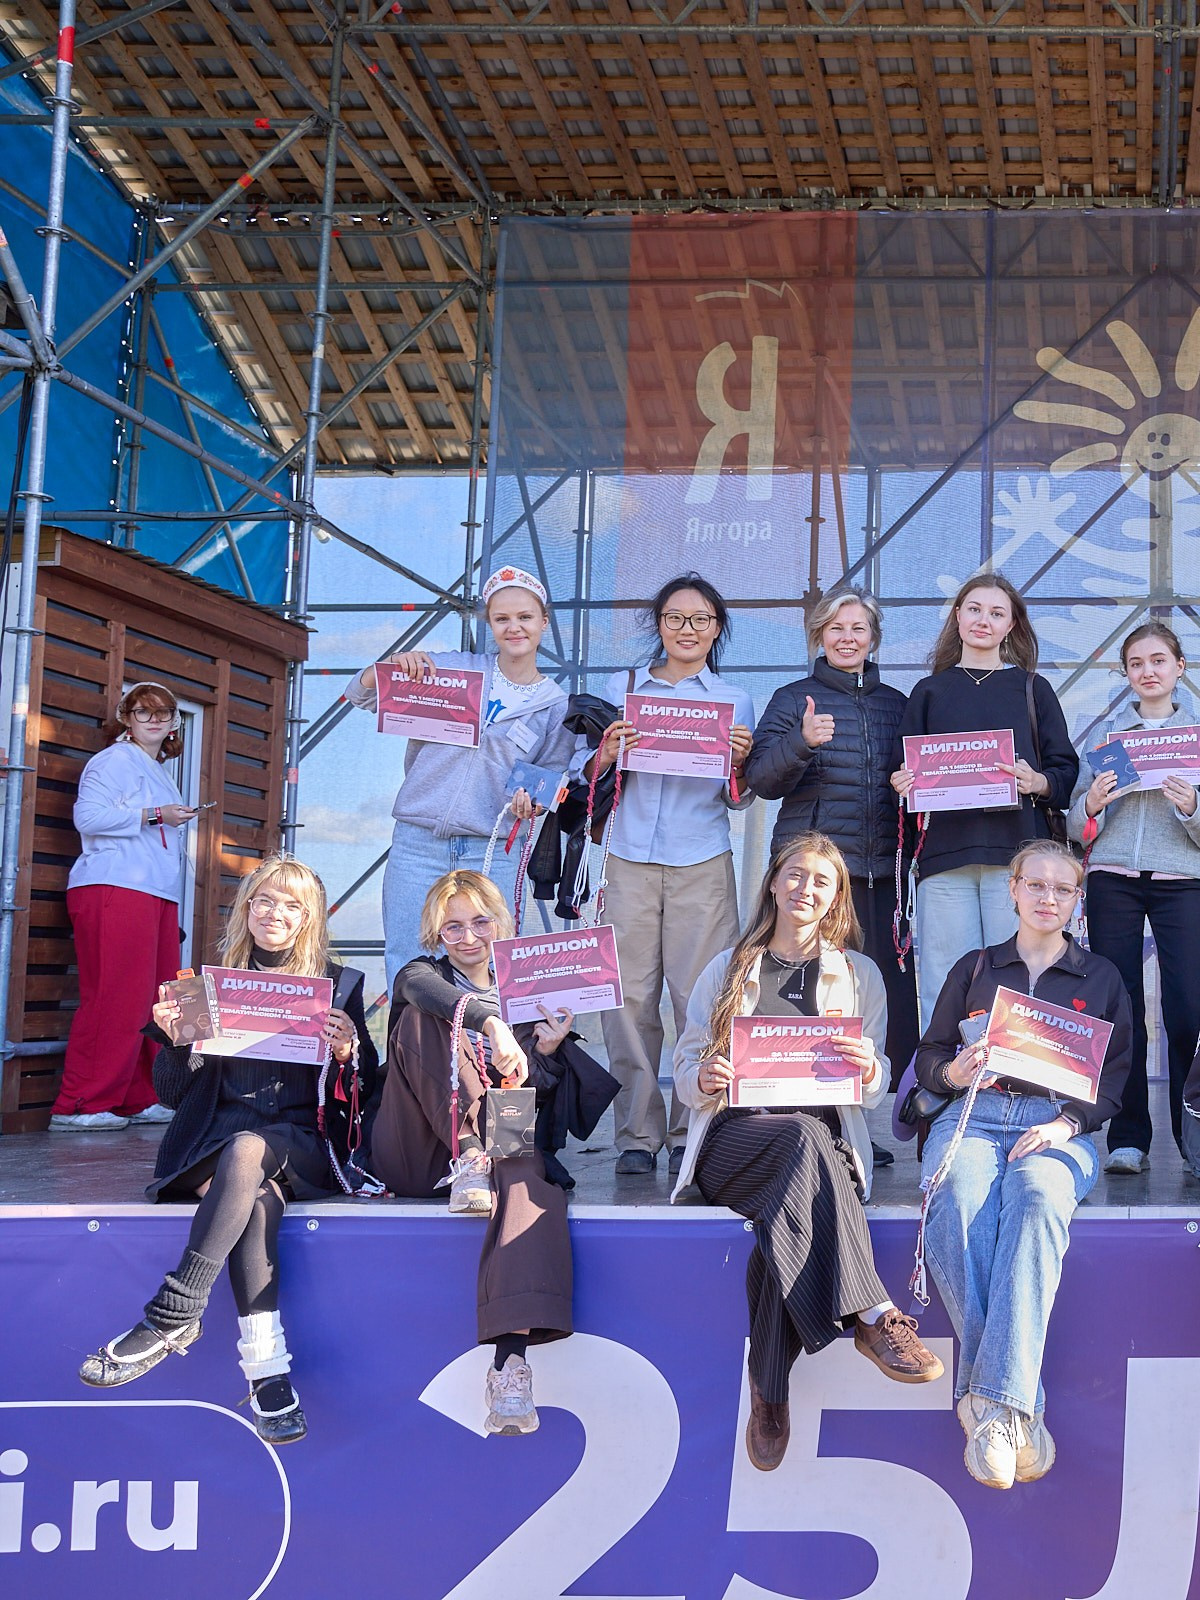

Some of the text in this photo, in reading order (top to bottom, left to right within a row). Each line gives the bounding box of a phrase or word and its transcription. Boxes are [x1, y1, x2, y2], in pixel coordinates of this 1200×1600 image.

[685, 335, 778, 503] Я
[685, 518, 772, 545] Ялгора
[640, 705, 719, 721] ДИПЛОМ
[638, 732, 691, 740] ТЕМАТИЧЕСКОМ
[1123, 734, 1198, 748] ДИПЛОМ
[920, 740, 998, 755] ДИПЛОМ
[922, 768, 974, 776] ТЕМАТИЧЕСКОМ
[511, 937, 598, 960] ДИПЛОМ
[514, 966, 602, 984] ТЕМАТИЧЕСКОМ КВЕСТЕ
[550, 965, 575, 973] МЕСТО
[222, 977, 314, 998] ДИПЛОМ
[220, 1008, 312, 1022] ТЕМАТИЧЕСКОМ КВЕСТЕ
[1011, 1002, 1094, 1040] ДИПЛОМ
[751, 1026, 844, 1038] ДИПЛОМ
[417, 1332, 973, 1600] 25
[0, 1449, 199, 1553] i.ru
